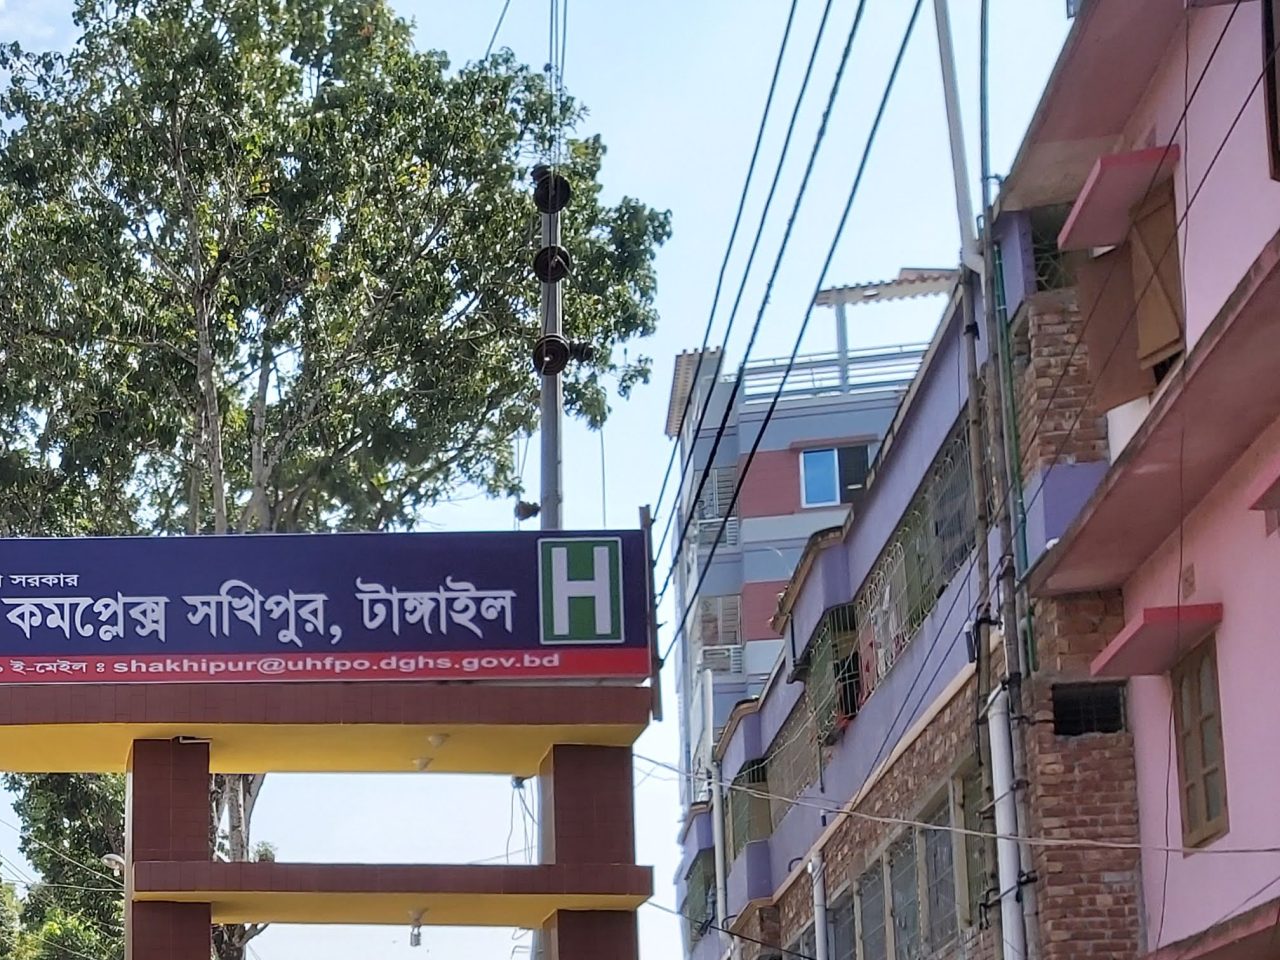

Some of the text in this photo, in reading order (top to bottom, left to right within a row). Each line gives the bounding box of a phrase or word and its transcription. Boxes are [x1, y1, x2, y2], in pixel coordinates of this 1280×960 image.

[10, 573, 80, 588] সরকার
[551, 546, 612, 636] H
[0, 591, 171, 642] কমপ্লেক্স
[181, 579, 343, 647] সখিপুর,
[355, 575, 517, 639] টাঙ্গাইল
[10, 659, 88, 676] ই-মেইল
[113, 653, 559, 676] shakhipur@uhfpo.dghs.gov.bd
